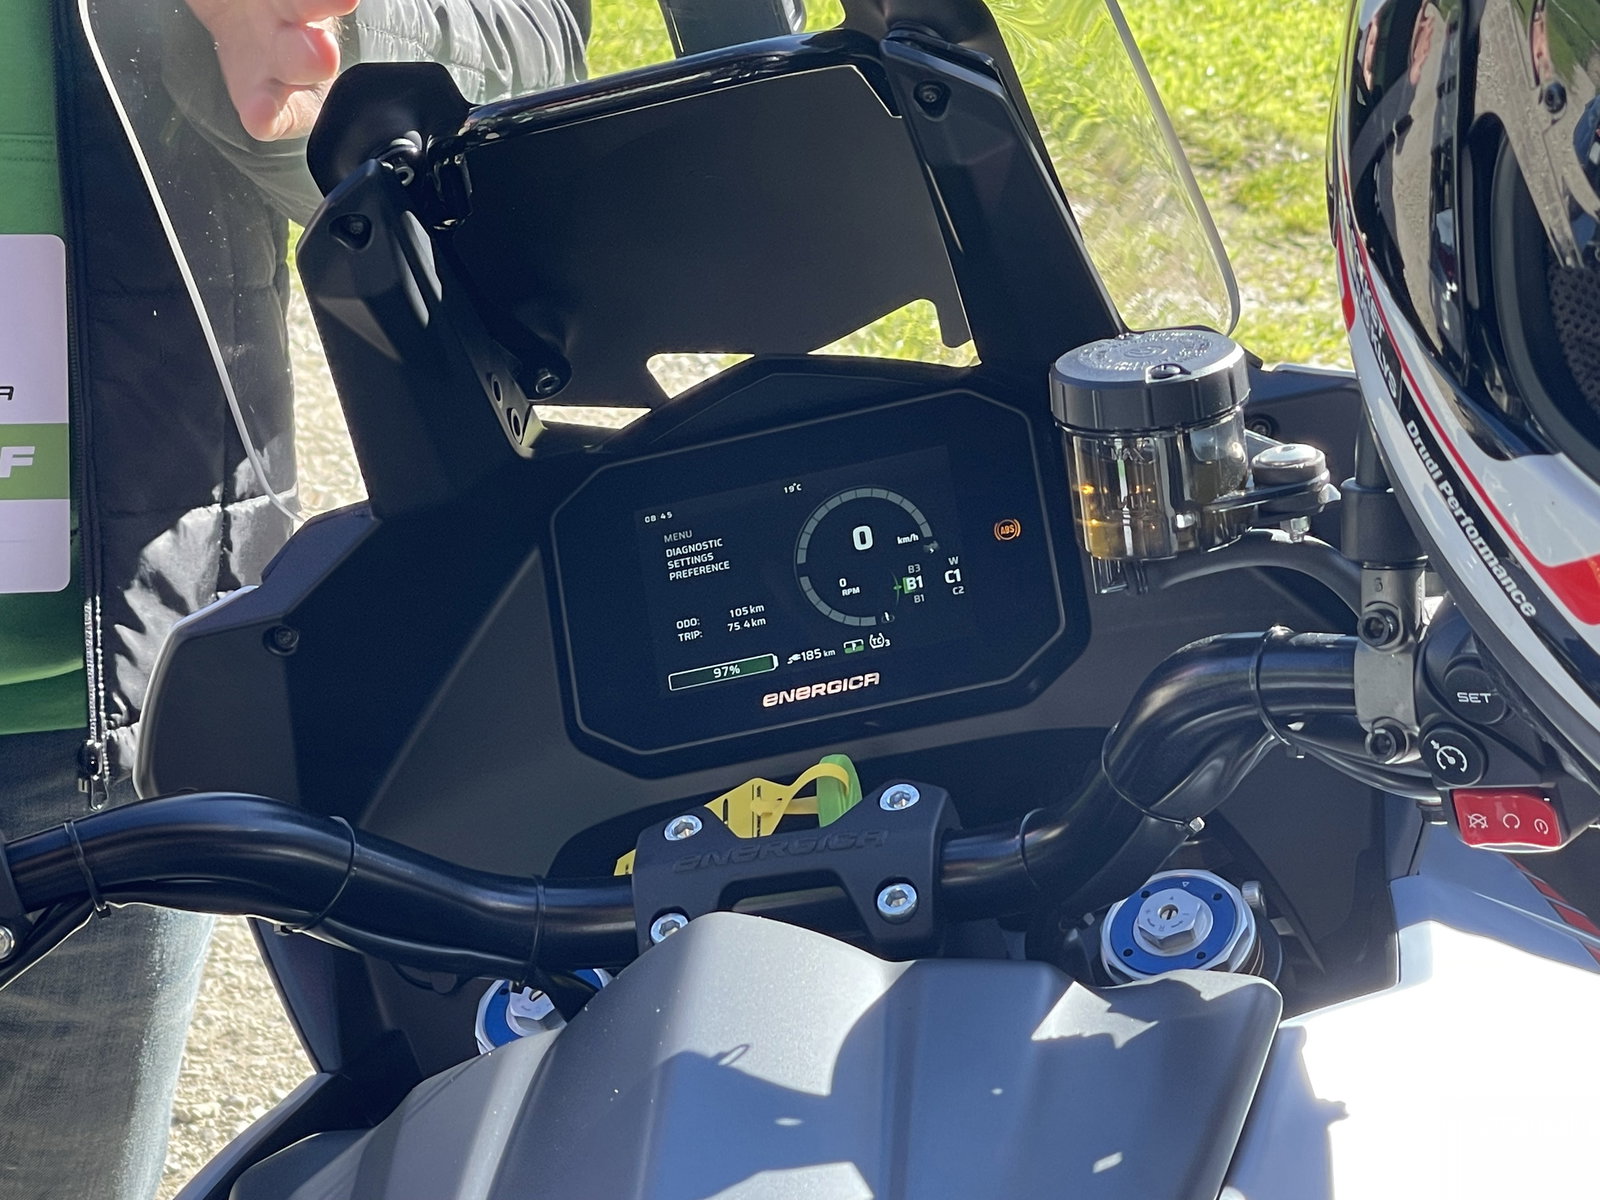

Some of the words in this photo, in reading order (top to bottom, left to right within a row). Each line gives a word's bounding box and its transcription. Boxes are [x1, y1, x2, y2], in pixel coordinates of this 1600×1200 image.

[1406, 419, 1443, 480] Drudi
[1438, 479, 1537, 617] Performance
[663, 529, 693, 543] MENU
[852, 525, 874, 551] 0
[896, 533, 919, 545] km/h
[1000, 524, 1015, 535] ABS
[665, 538, 723, 558] DIAGNOSTIC
[667, 552, 714, 570] SETTINGS
[907, 563, 921, 574] B3
[948, 555, 959, 566] W
[669, 560, 730, 581] PREFERENCE
[838, 577, 848, 588] 0
[906, 575, 924, 592] B1
[944, 568, 962, 584] C1
[841, 586, 861, 597] RPM
[913, 593, 925, 604] B1
[952, 585, 965, 596] C2
[729, 606, 749, 618] 105
[750, 604, 765, 614] km
[751, 617, 767, 627] km
[802, 648, 822, 661] 185
[823, 649, 836, 657] km
[713, 664, 741, 679] 97%
[762, 671, 880, 708] ENERGICA
[1456, 691, 1492, 704] SET
[672, 829, 889, 873] ENERGICA
